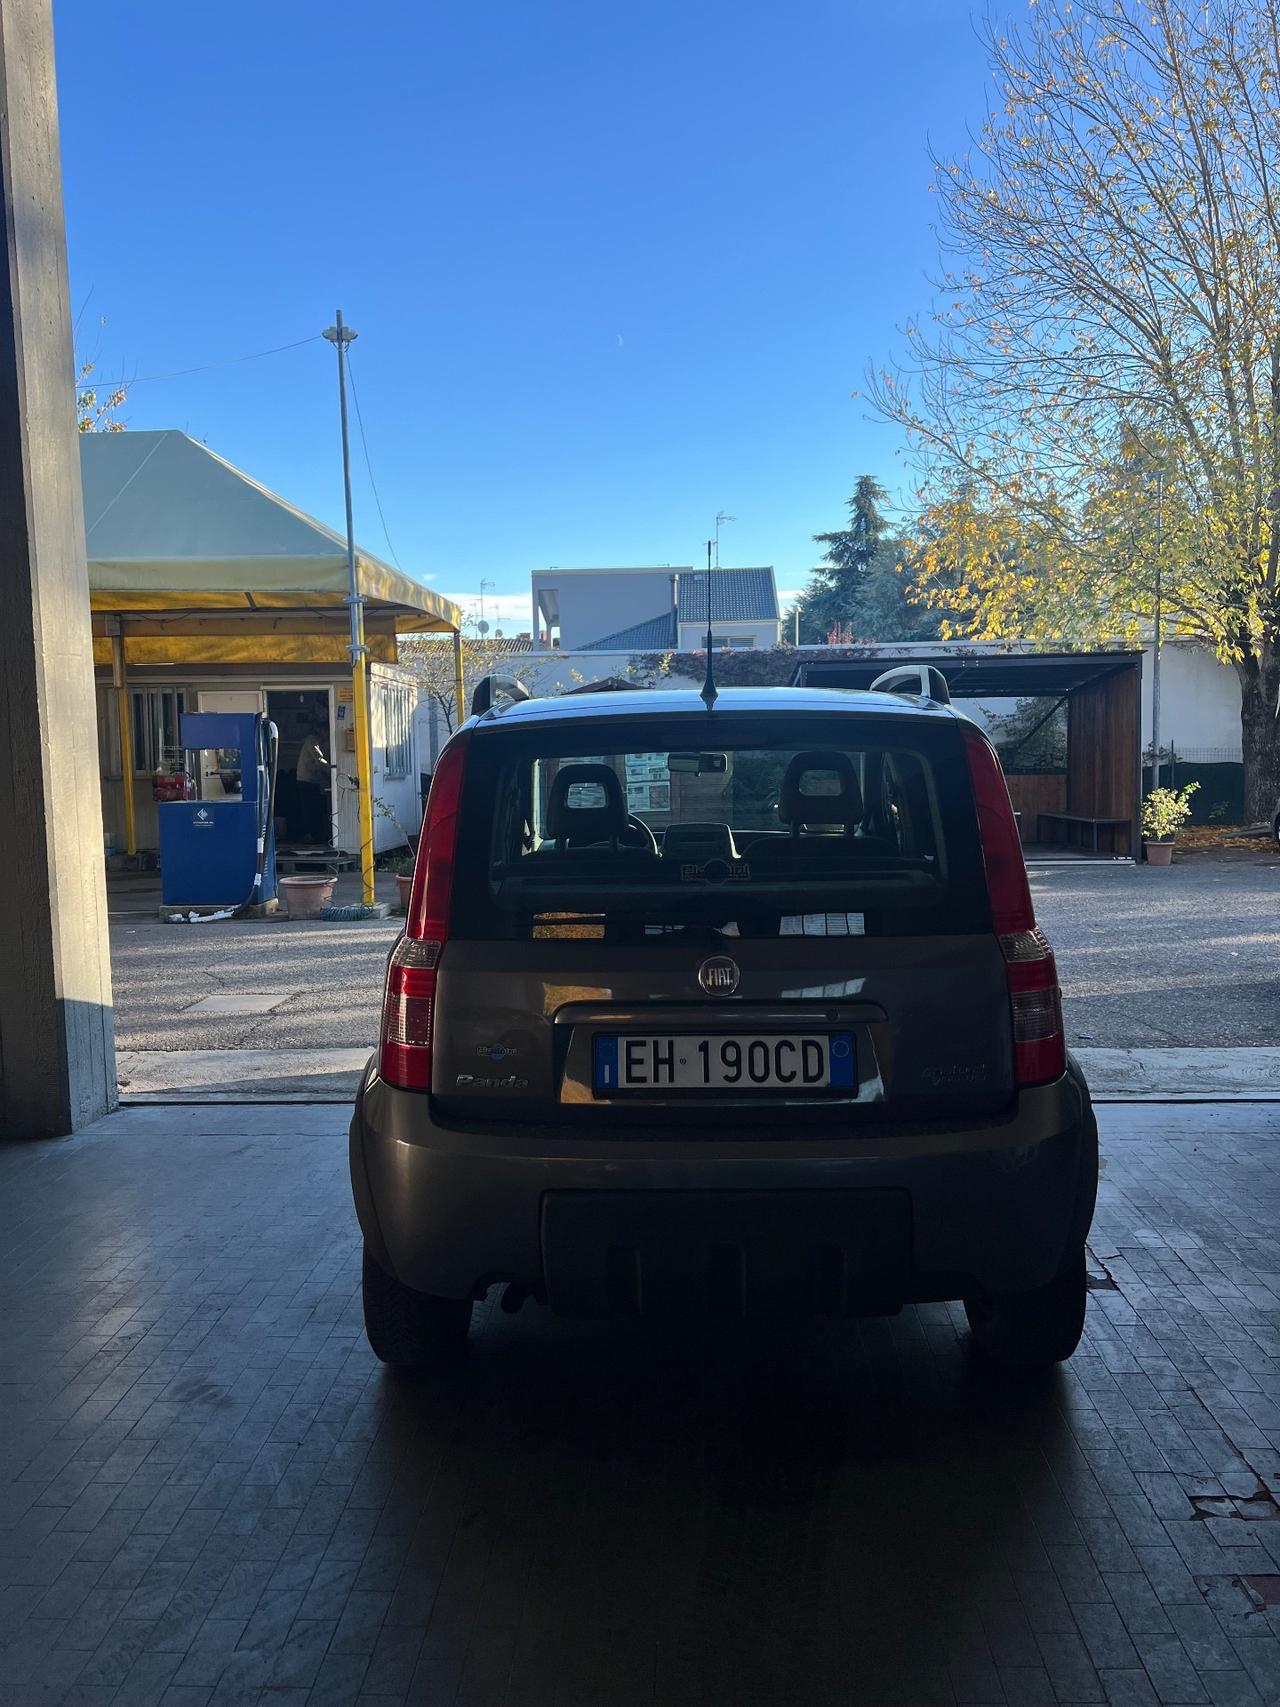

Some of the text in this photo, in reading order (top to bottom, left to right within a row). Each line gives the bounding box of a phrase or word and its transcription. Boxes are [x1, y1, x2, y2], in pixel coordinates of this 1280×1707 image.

[707, 967, 733, 986] FIAT
[625, 1040, 824, 1083] EH 190CD
[455, 1072, 529, 1089] Panda
